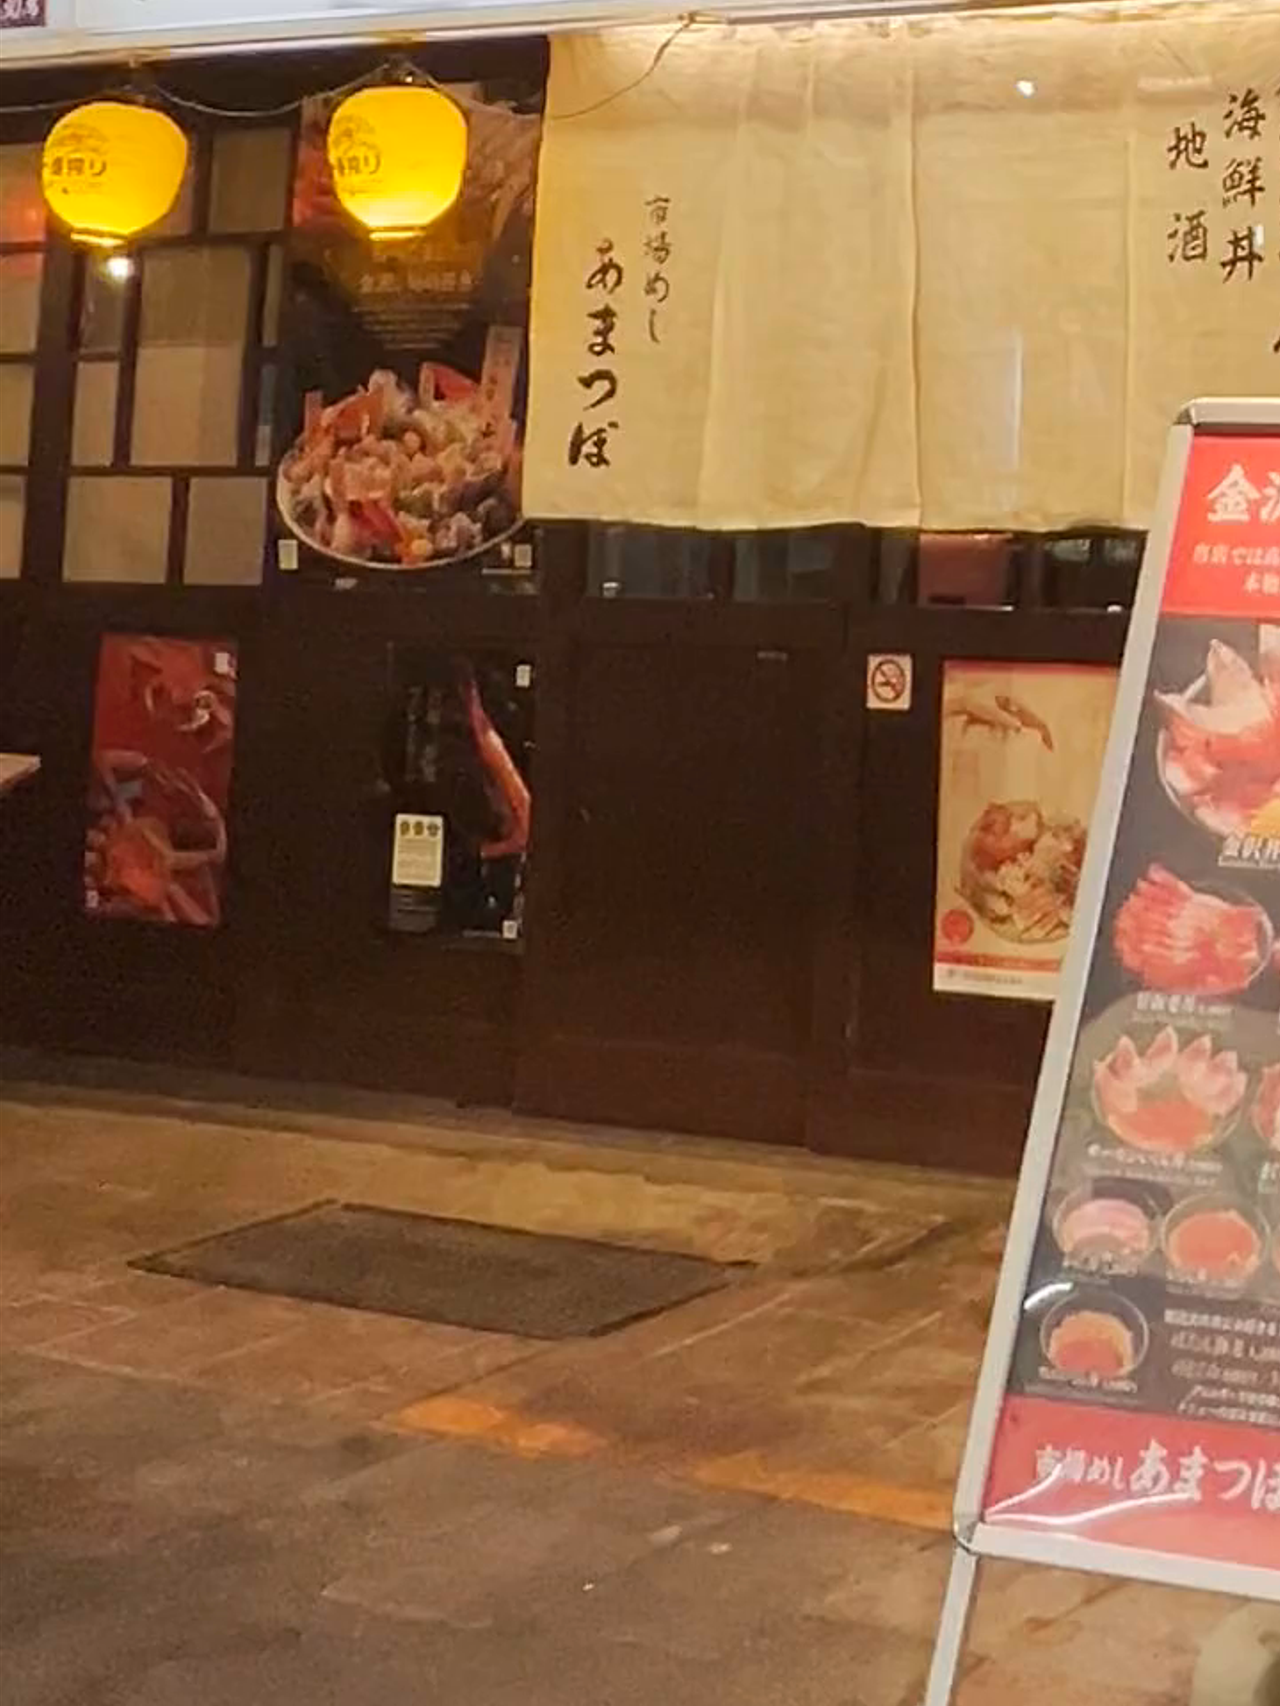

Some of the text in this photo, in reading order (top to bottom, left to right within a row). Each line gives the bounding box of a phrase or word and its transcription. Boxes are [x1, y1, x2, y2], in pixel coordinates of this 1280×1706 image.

[644, 194, 671, 344] 市場めし
[1167, 122, 1210, 264] 地酒
[1220, 88, 1267, 283] 海鮮丼
[568, 237, 624, 468] あまつぼ
